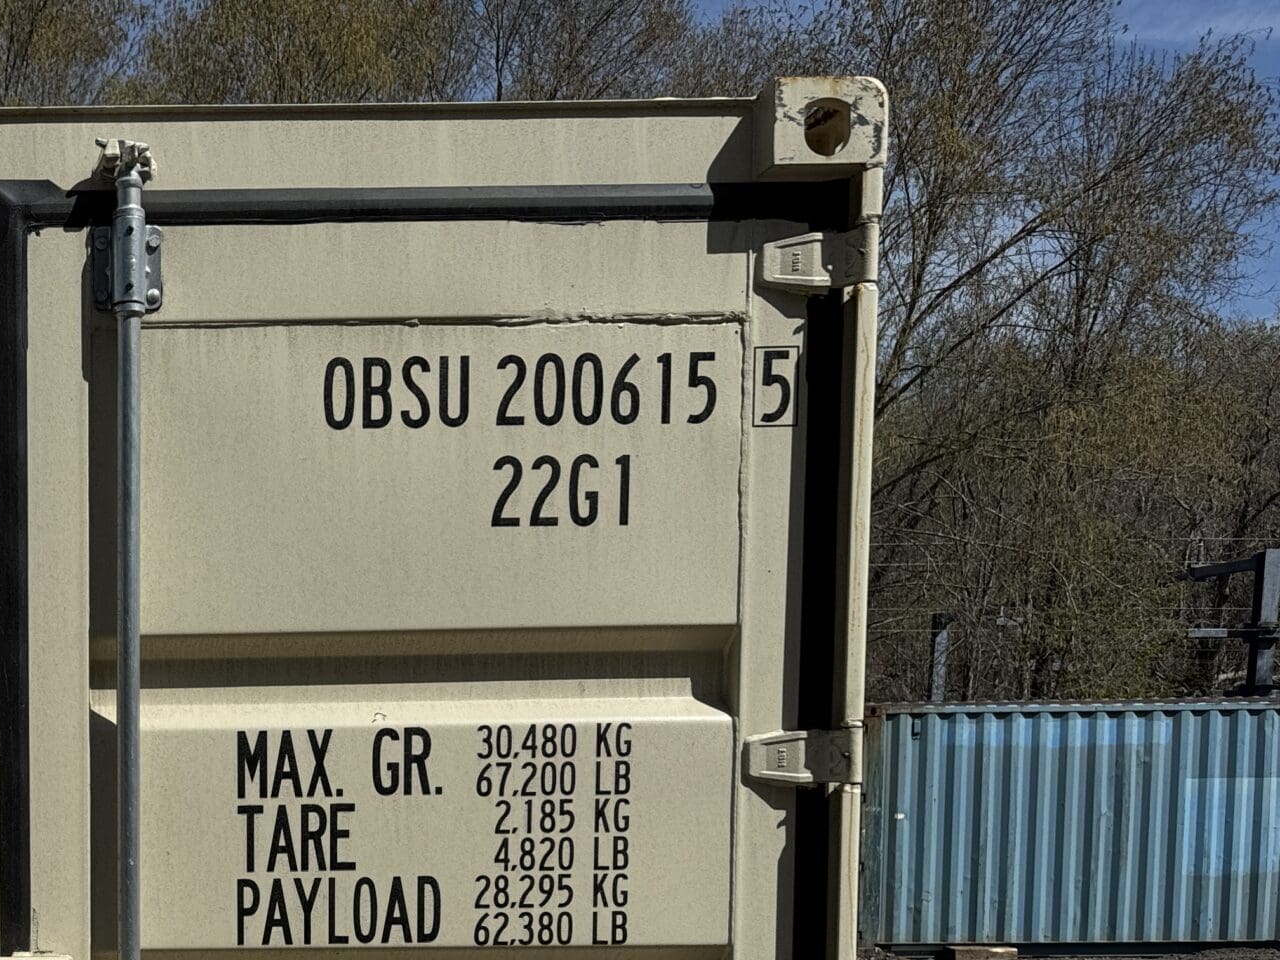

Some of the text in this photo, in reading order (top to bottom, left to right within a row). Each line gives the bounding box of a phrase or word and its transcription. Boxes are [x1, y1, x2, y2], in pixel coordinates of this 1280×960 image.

[324, 349, 792, 431] OBSU 200615 5
[490, 454, 631, 527] 22G1
[476, 722, 633, 760] 30,480 KG
[236, 726, 444, 799] MAX. GR.
[476, 760, 631, 798] 67,200 LB
[494, 798, 630, 835] 2,185 KG
[237, 803, 357, 873] TARE
[493, 836, 629, 872] 4,820 LB
[236, 875, 442, 946] PAYLOAD
[474, 873, 629, 910] 28,295 KG
[473, 911, 628, 946] 62,380 LB
